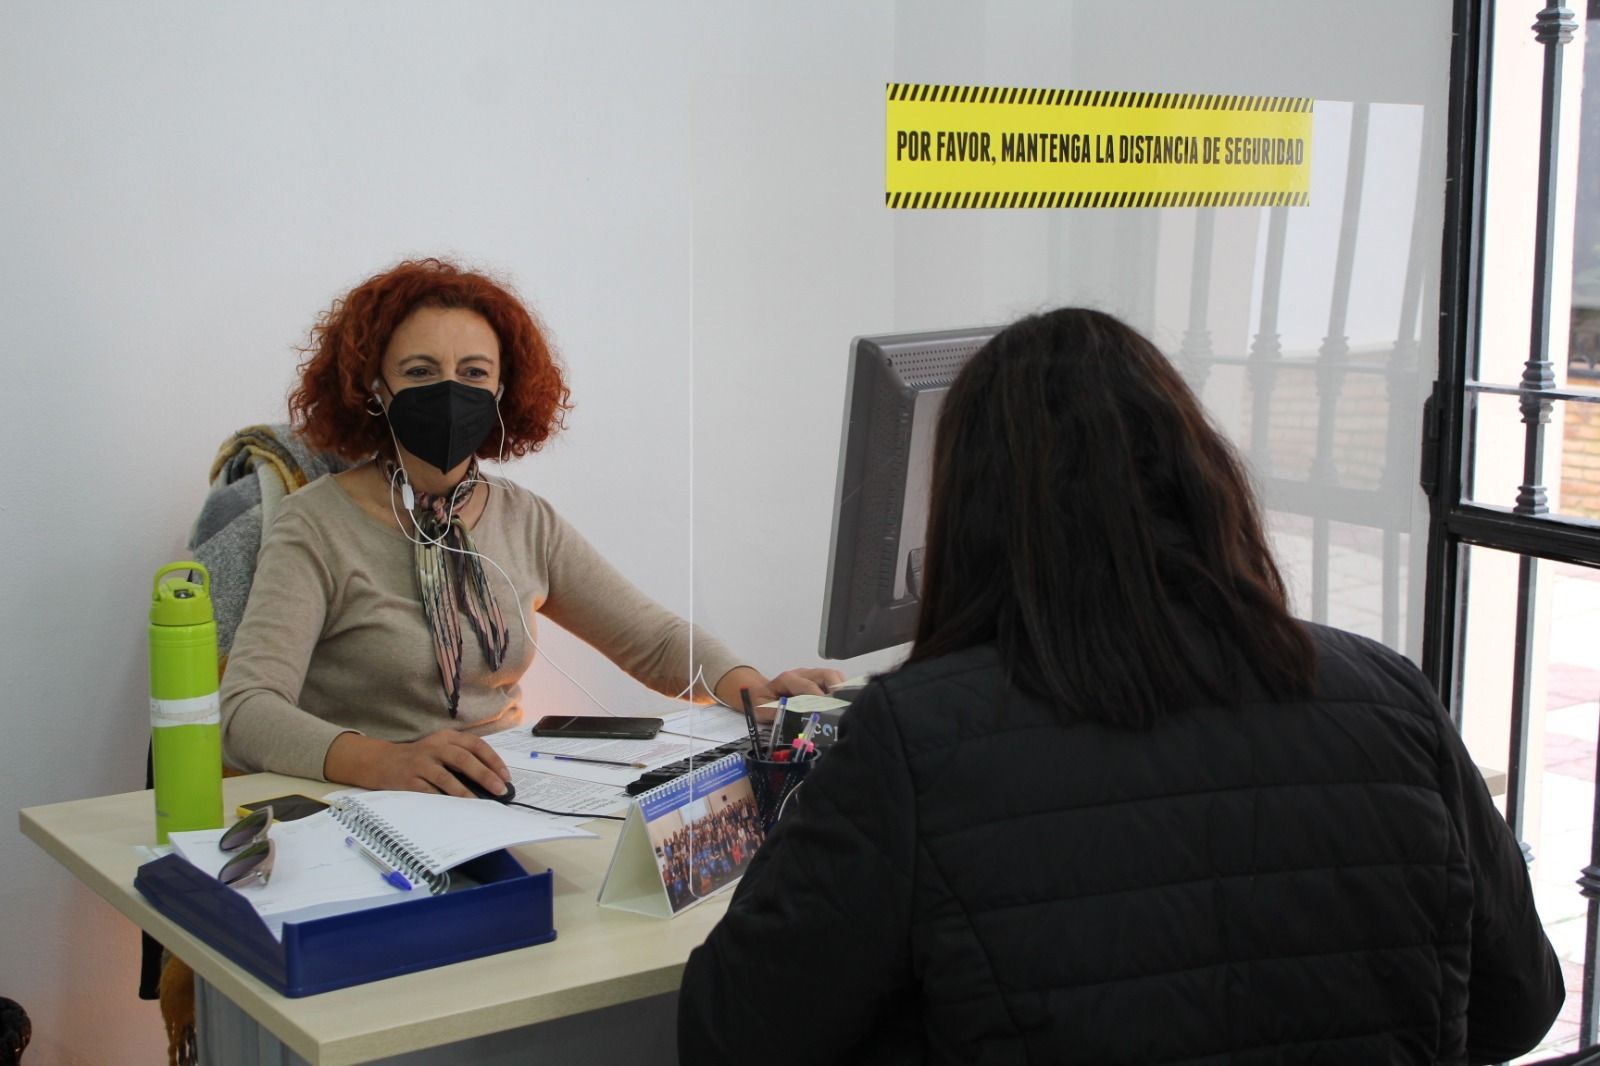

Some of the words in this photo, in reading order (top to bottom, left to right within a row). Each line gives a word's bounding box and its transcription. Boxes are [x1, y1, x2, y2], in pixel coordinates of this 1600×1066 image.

[896, 130, 931, 162] POR
[937, 131, 996, 166] FAVOR,
[1001, 132, 1091, 164] MANTENGA
[1095, 134, 1115, 164] LA
[1119, 135, 1199, 165] DISTANCIA
[1203, 136, 1221, 165] DE
[1225, 137, 1304, 166] SEGURIDAD
